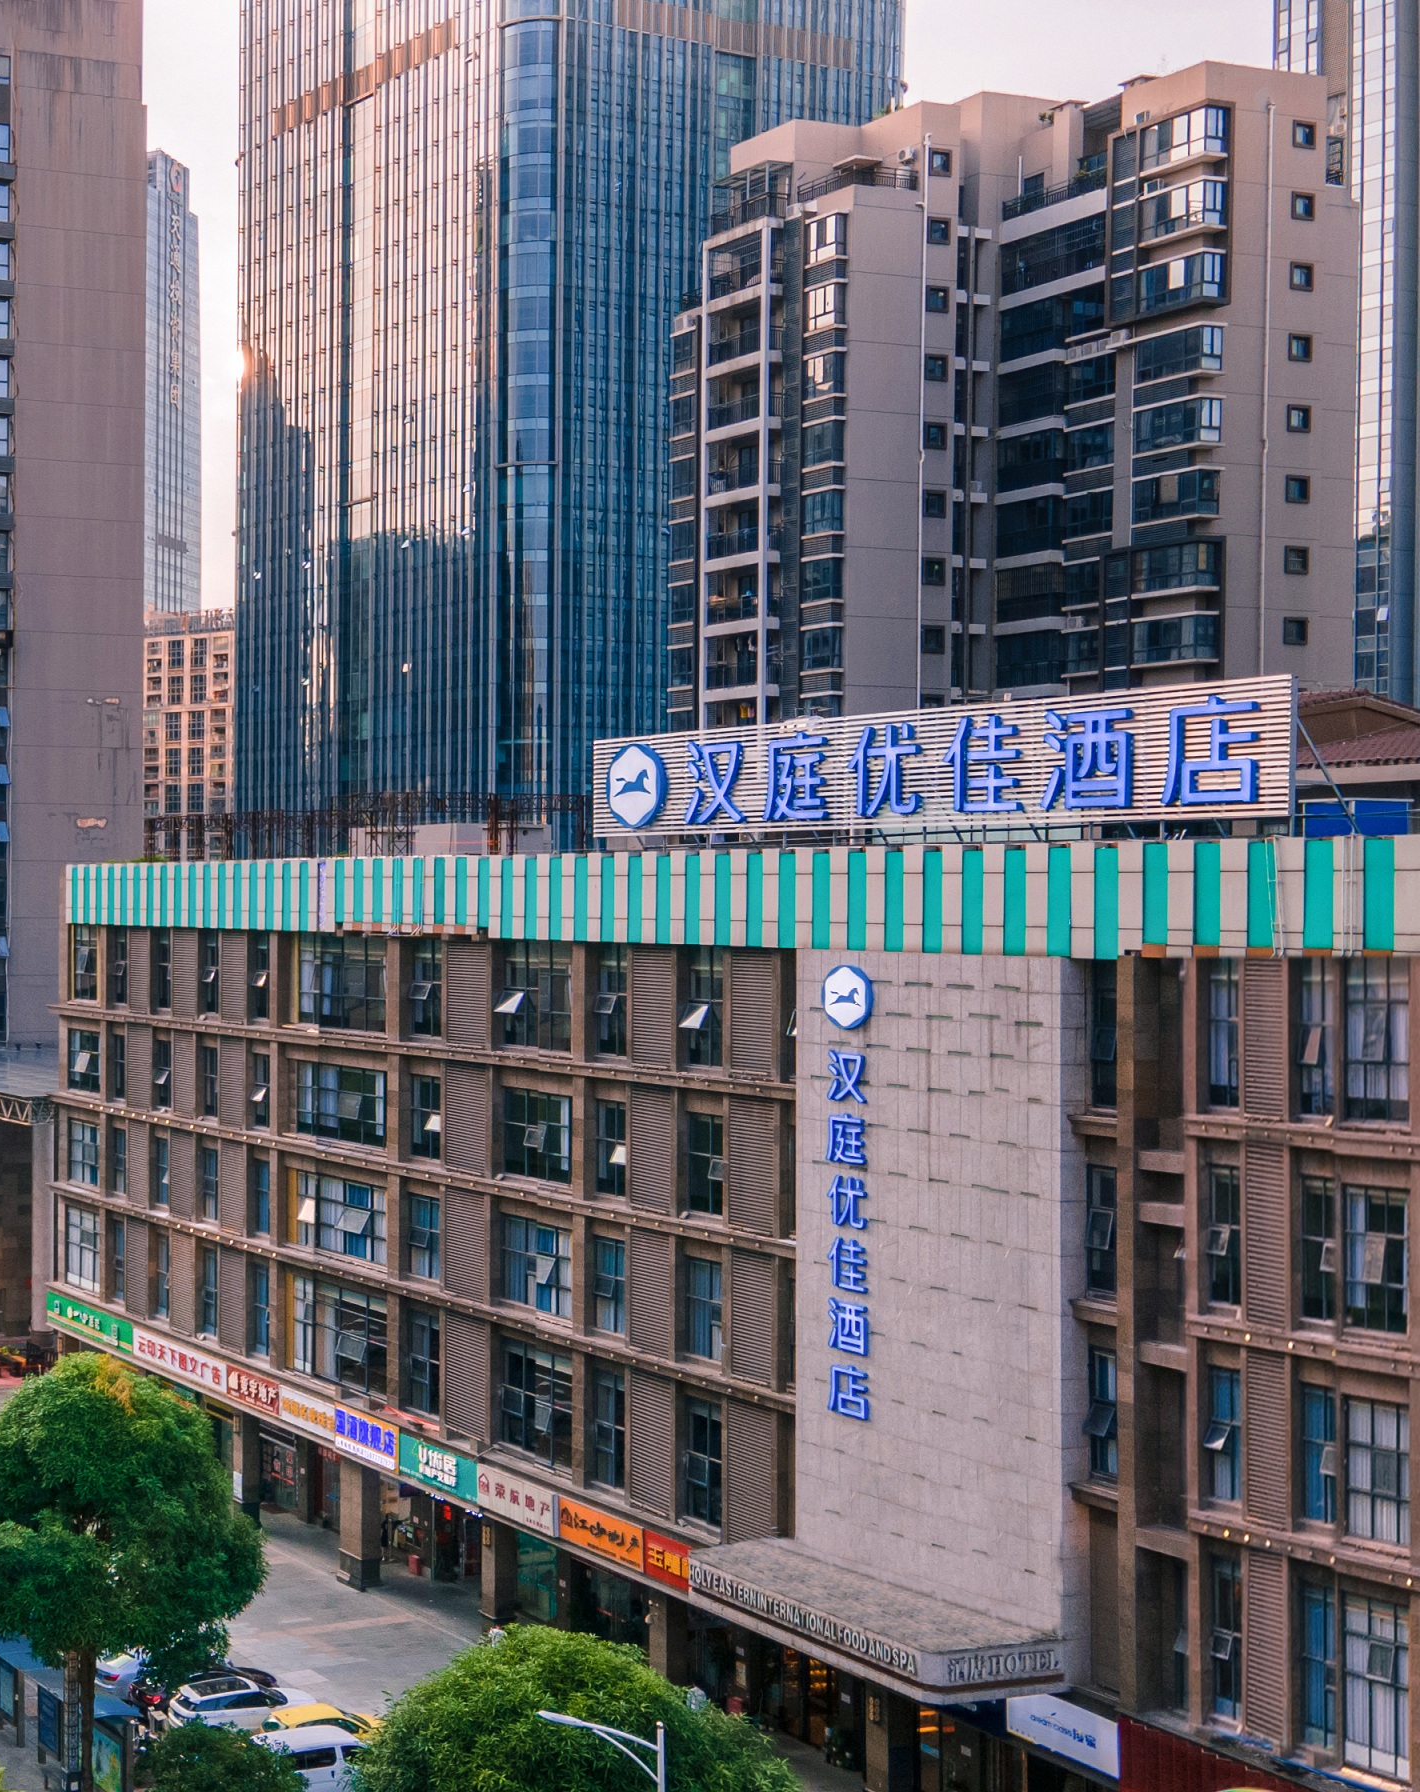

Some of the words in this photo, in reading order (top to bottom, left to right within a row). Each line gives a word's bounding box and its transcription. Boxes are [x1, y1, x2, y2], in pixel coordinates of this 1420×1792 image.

[684, 694, 1262, 826] 汉庭优佳酒店
[825, 1048, 871, 1421] 汉庭优佳酒店
[494, 1482, 551, 1517] 荣航地产
[837, 1626, 868, 1652] FOOD
[988, 1650, 1060, 1676] HOTEL
